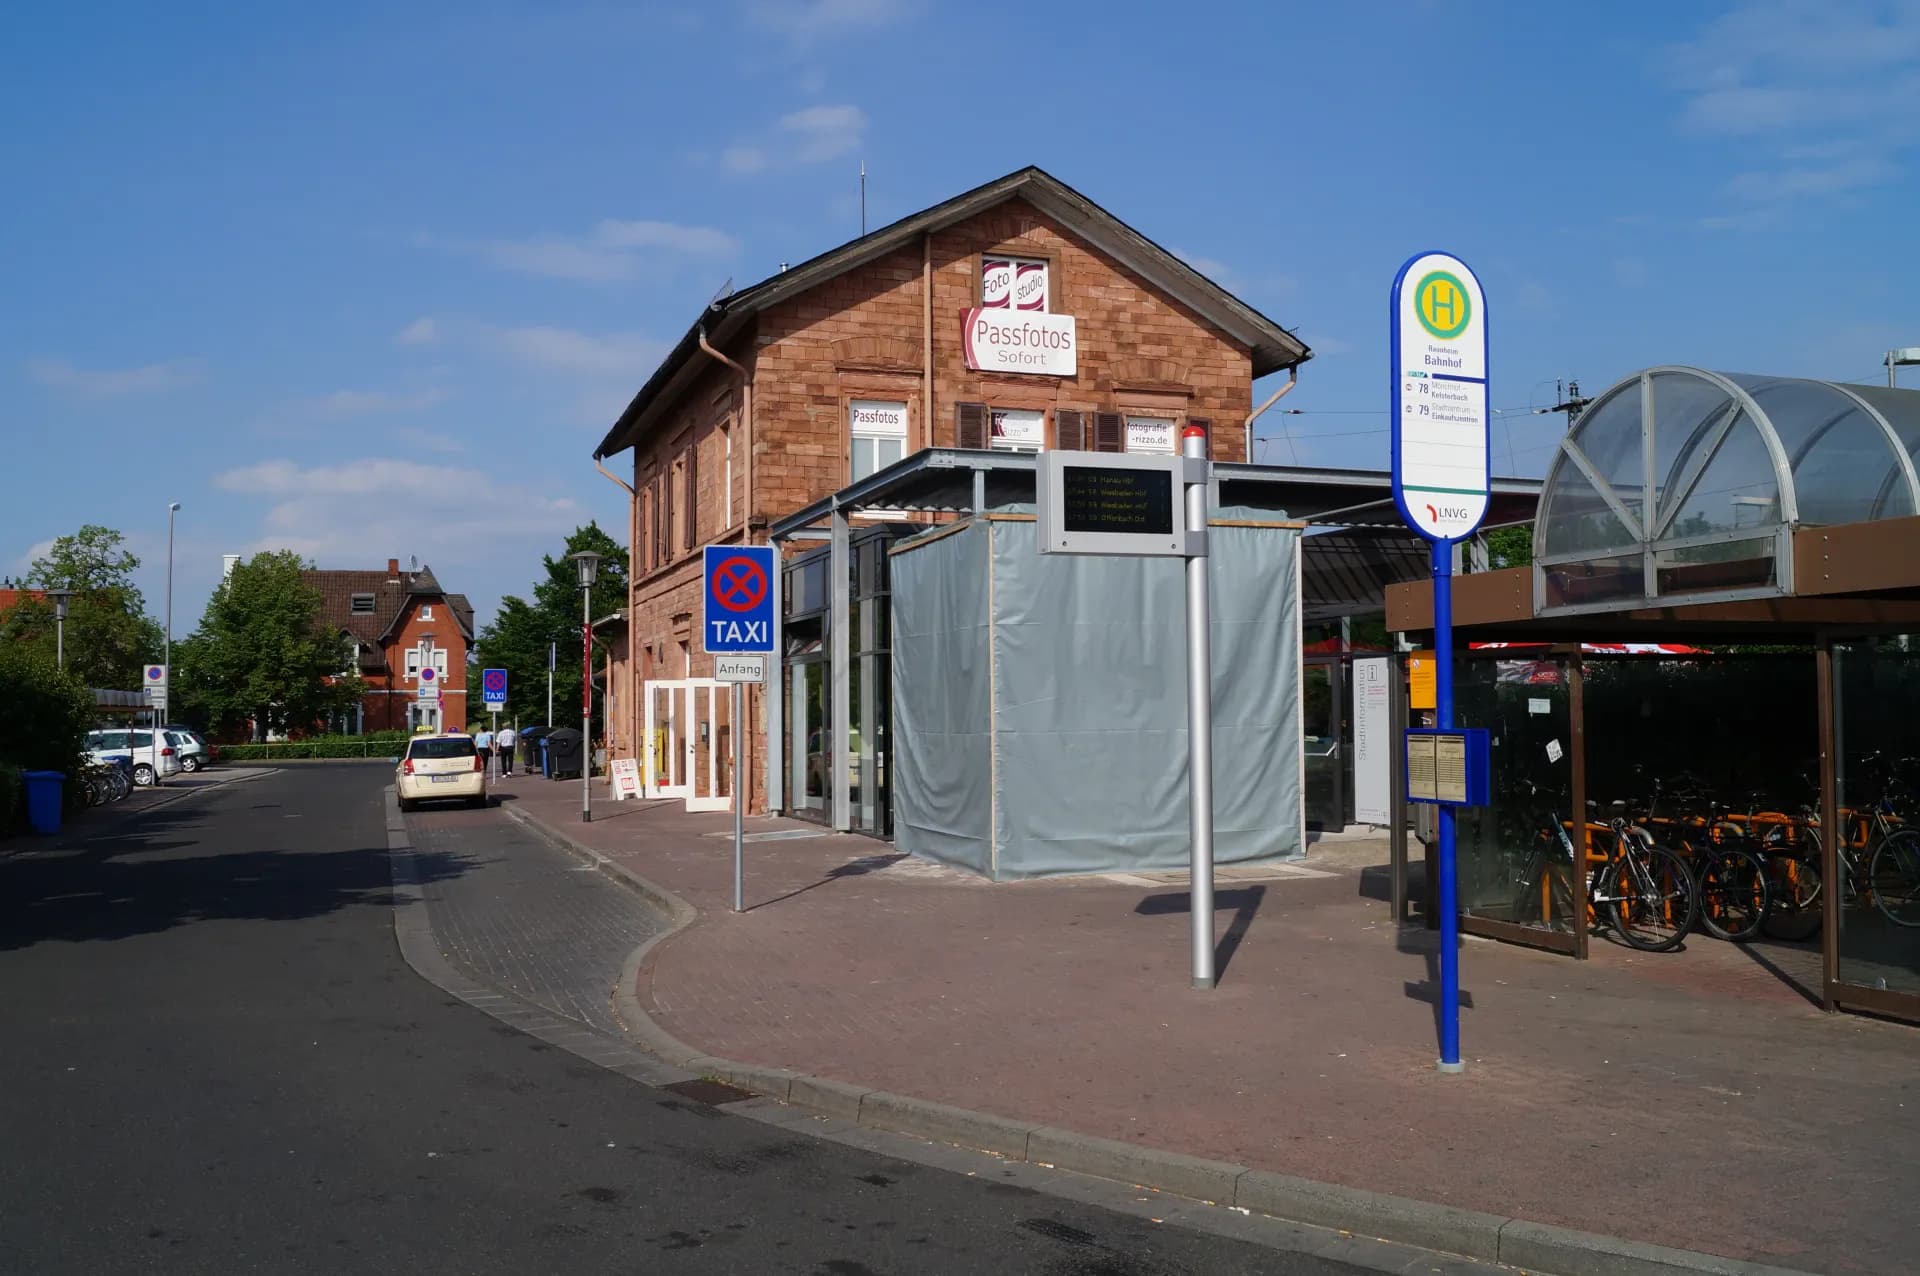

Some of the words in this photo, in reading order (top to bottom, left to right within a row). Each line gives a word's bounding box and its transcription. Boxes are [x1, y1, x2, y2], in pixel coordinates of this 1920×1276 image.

[983, 272, 1010, 297] Foto
[1017, 274, 1043, 300] studio
[1432, 285, 1455, 325] H
[977, 320, 1071, 350] Passfotos
[998, 350, 1046, 365] Sofort
[1424, 354, 1462, 368] Bahnhof
[1418, 383, 1429, 394] 78
[1431, 391, 1468, 401] Kelsterbach
[853, 409, 899, 424] Passfotos
[1418, 404, 1430, 416] 79
[1132, 435, 1168, 445] -rizzo.de
[1439, 507, 1468, 519] LNVG
[711, 620, 767, 643] TAXI
[719, 663, 761, 677] Anfang
[486, 691, 504, 700] TAXI
